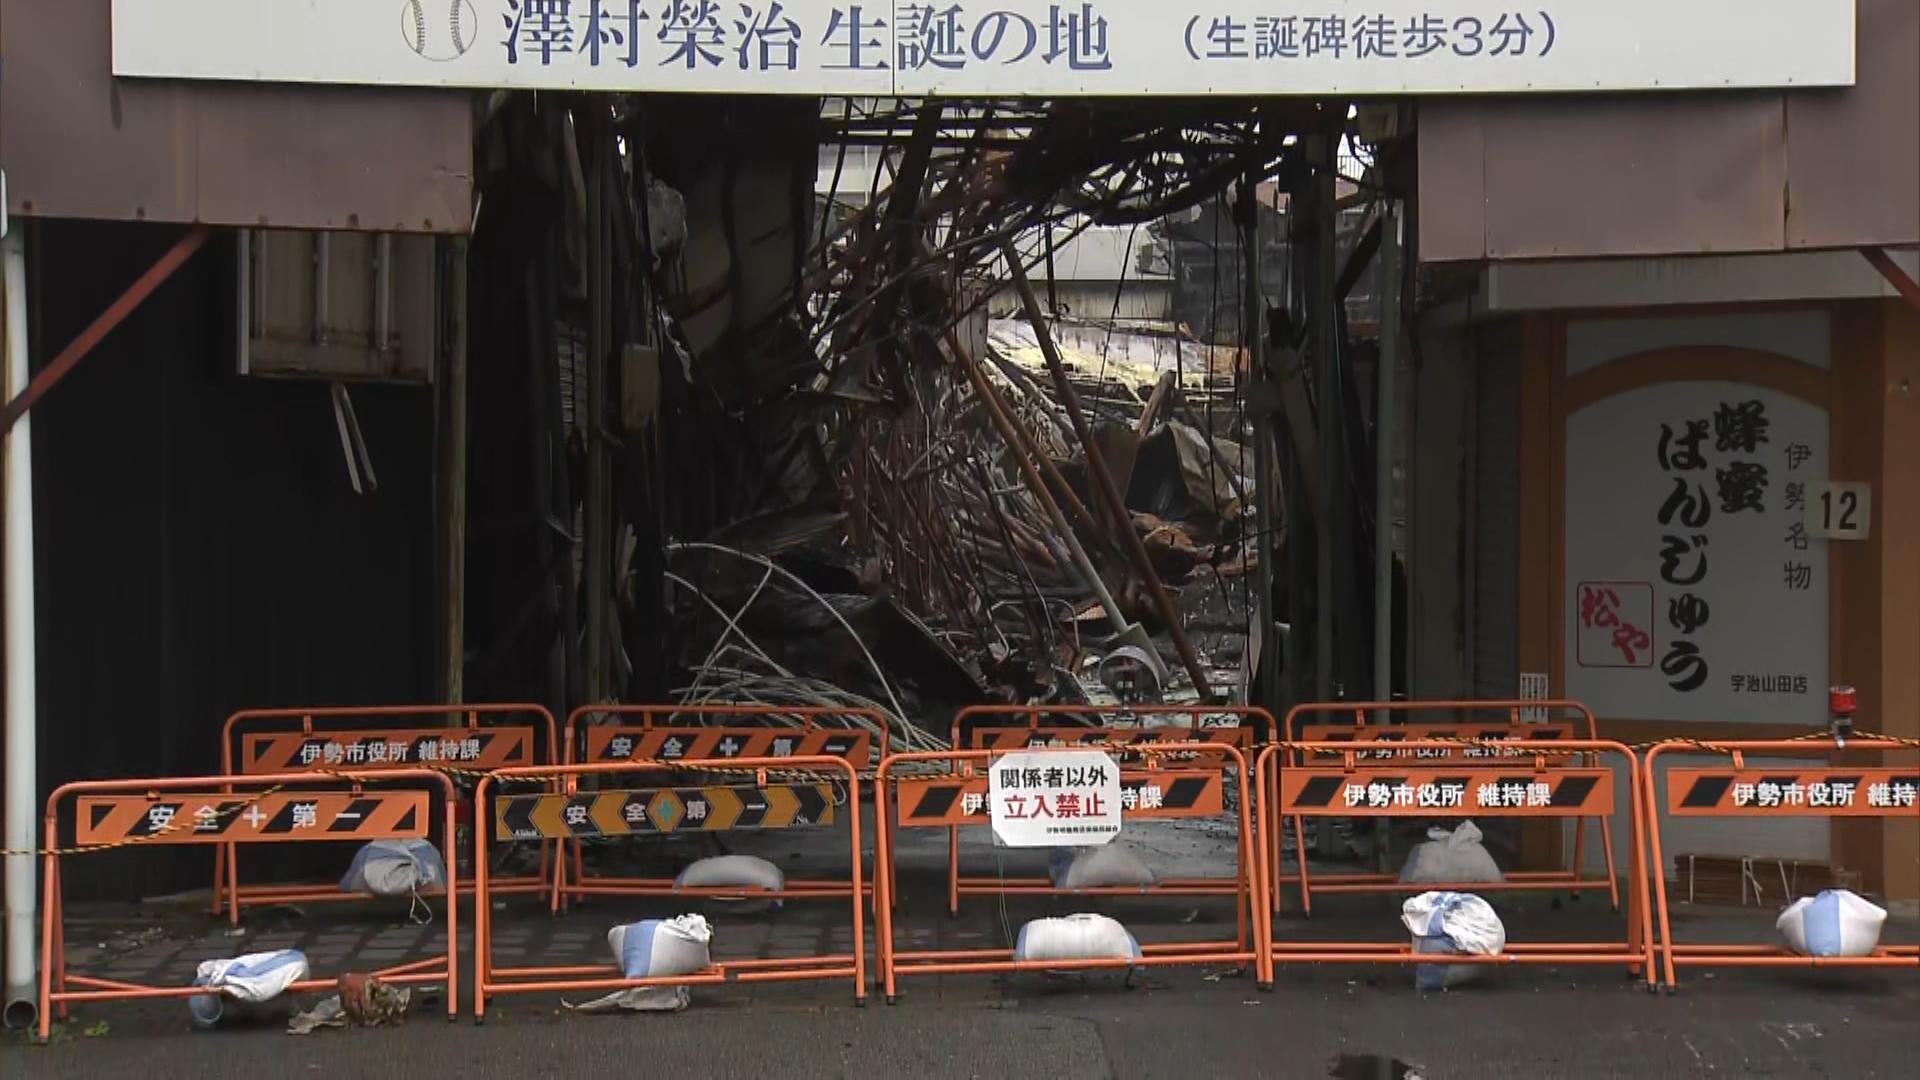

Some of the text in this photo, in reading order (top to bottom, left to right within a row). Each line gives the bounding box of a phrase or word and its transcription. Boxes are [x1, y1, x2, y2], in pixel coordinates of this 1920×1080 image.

[1820, 491, 1857, 530] 12
[1730, 674, 1808, 694] 宇治山田店
[300, 739, 480, 764] 伊勢市役所 維持課
[1000, 765, 1108, 789] 関係者以外
[1004, 791, 1107, 819] 立入禁止
[1343, 782, 1551, 807] 伊勢市役所 維持課
[1732, 782, 1855, 806] 伊勢市役所
